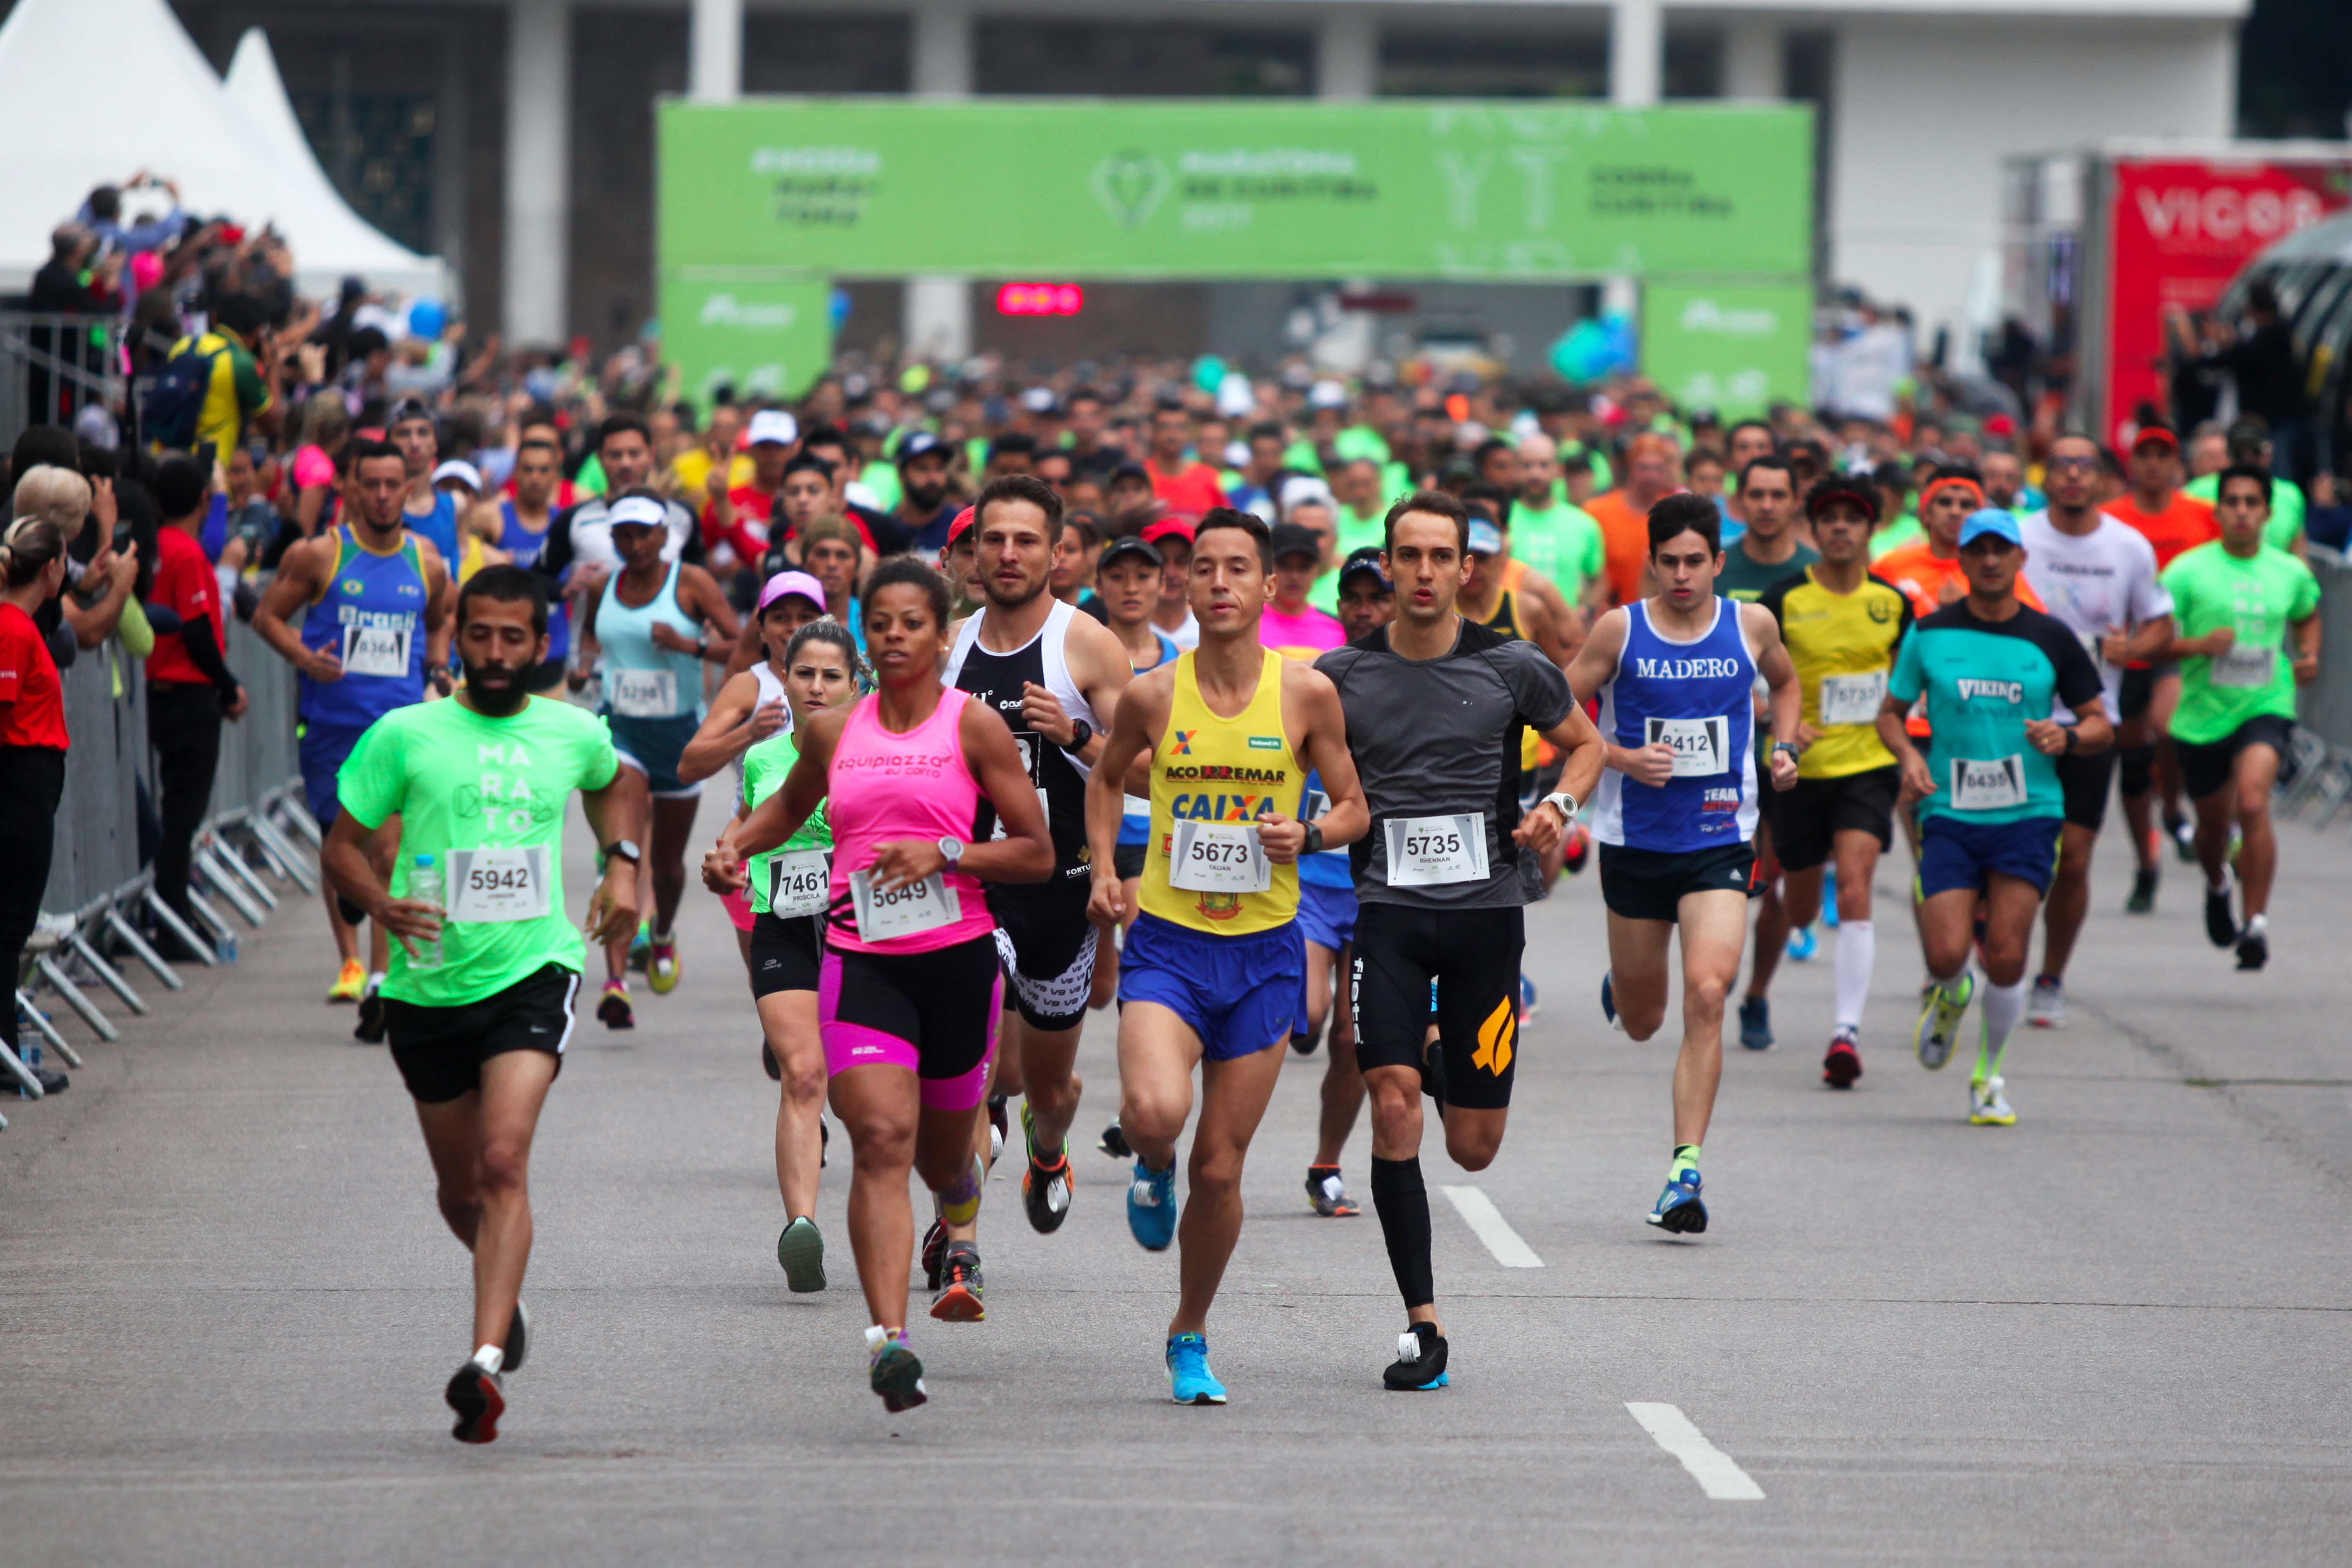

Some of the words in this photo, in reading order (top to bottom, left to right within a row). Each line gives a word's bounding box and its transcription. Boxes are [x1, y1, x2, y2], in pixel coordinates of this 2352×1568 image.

[338, 604, 417, 630] Brasil
[1636, 658, 1738, 679] MADERO
[1957, 679, 2023, 704] VIKING
[1662, 735, 1708, 751] 8412
[1704, 788, 1738, 801] TEAM
[1172, 794, 1274, 821] CAIXA
[1192, 841, 1248, 863] 5673
[1407, 834, 1460, 856] 5735
[470, 868, 528, 890] 5942
[782, 870, 828, 895] 7461
[793, 893, 820, 902] PRISCILA
[872, 880, 927, 908] 5649
[1027, 989, 1039, 1001] V8
[1034, 982, 1047, 992] V8
[1069, 985, 1081, 993] V8
[1043, 998, 1060, 1007] V8
[1064, 997, 1078, 1006] V8
